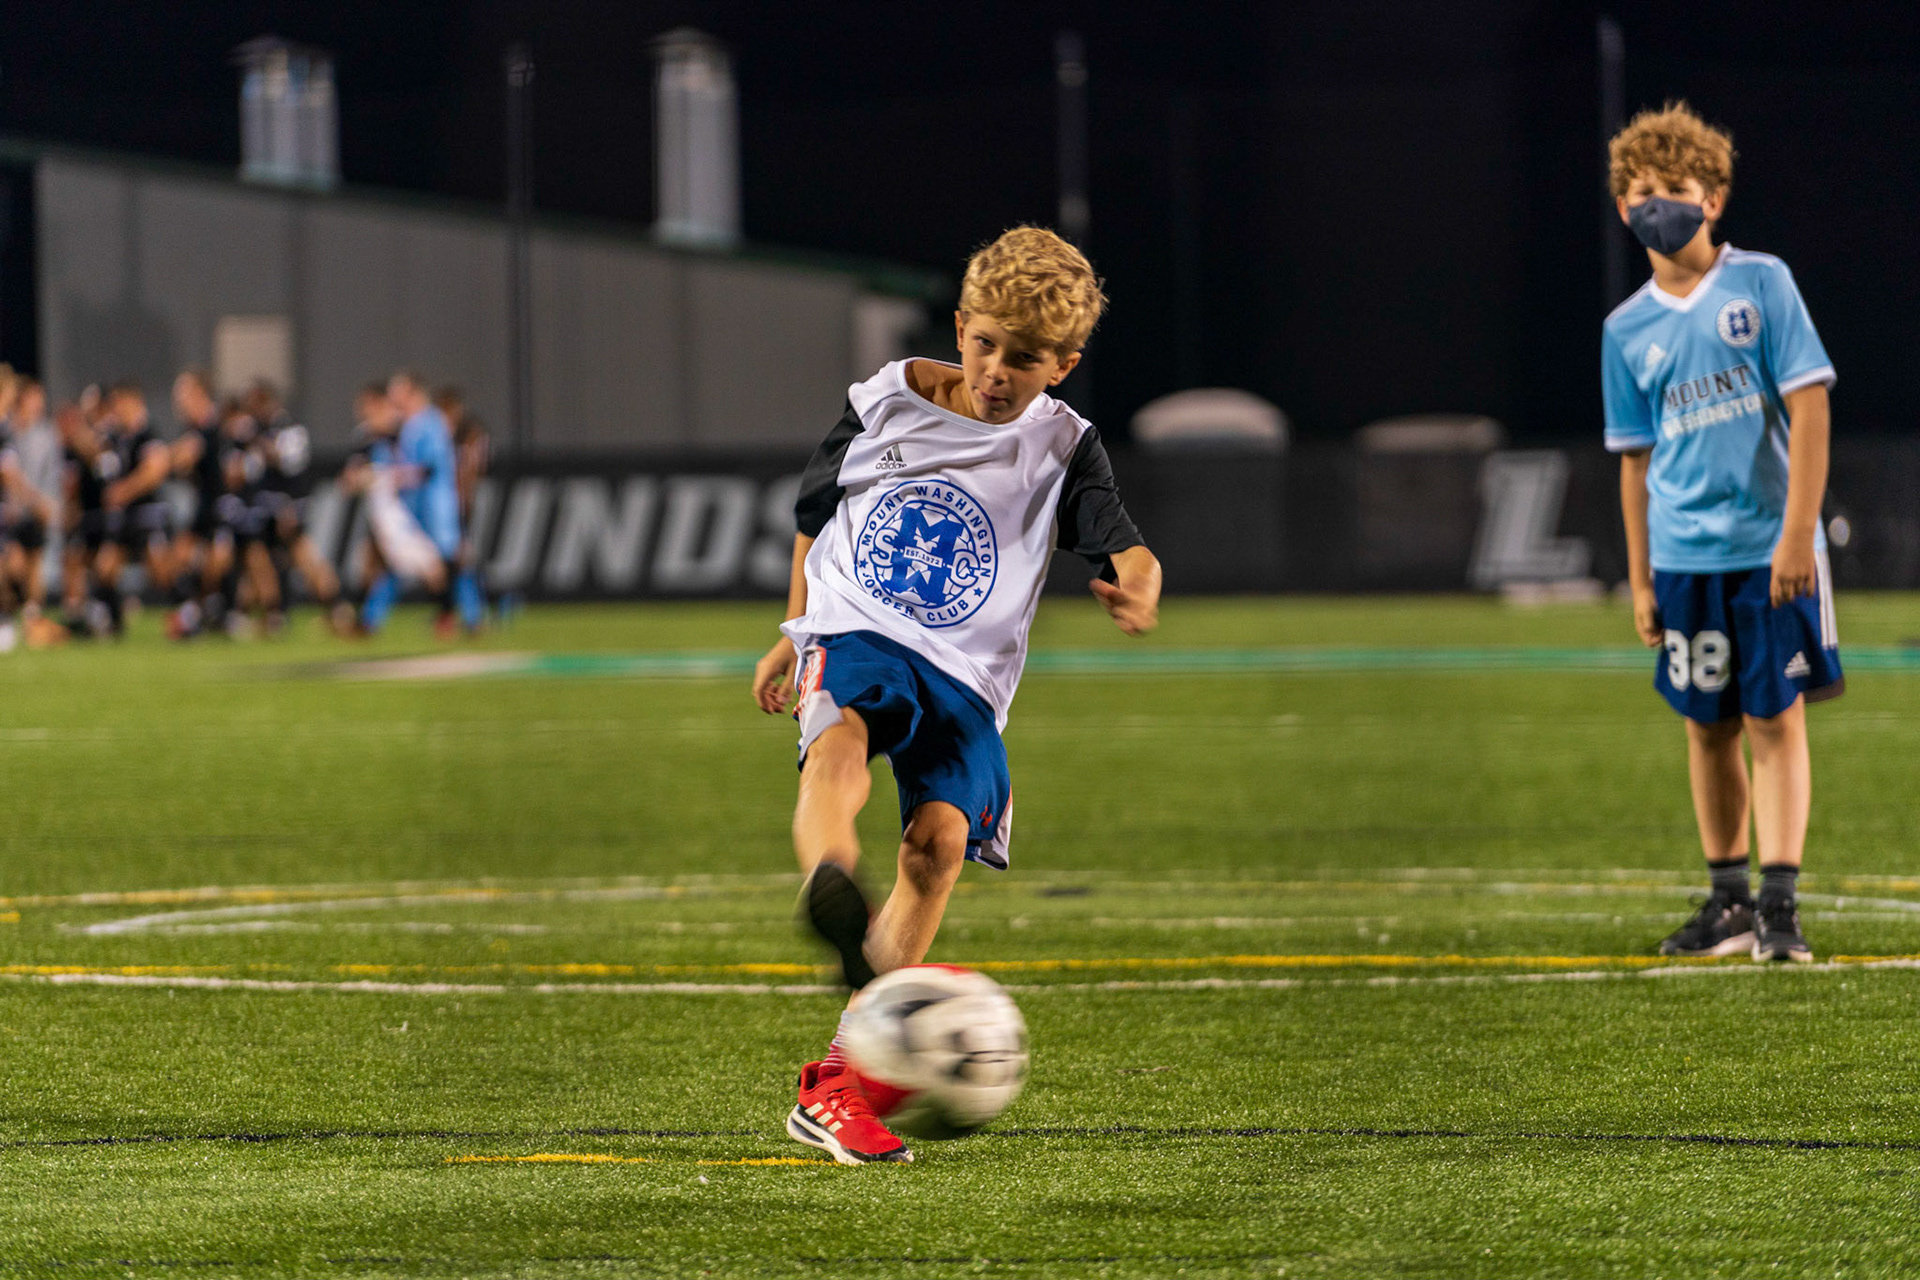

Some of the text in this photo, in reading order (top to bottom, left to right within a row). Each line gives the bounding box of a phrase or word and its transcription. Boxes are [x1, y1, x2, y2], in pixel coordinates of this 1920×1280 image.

[1663, 364, 1749, 410] MOUNT
[861, 486, 992, 578] MOUNT WASHINGTON
[862, 572, 969, 622] SOCCER CLUB
[1665, 629, 1731, 692] 38
